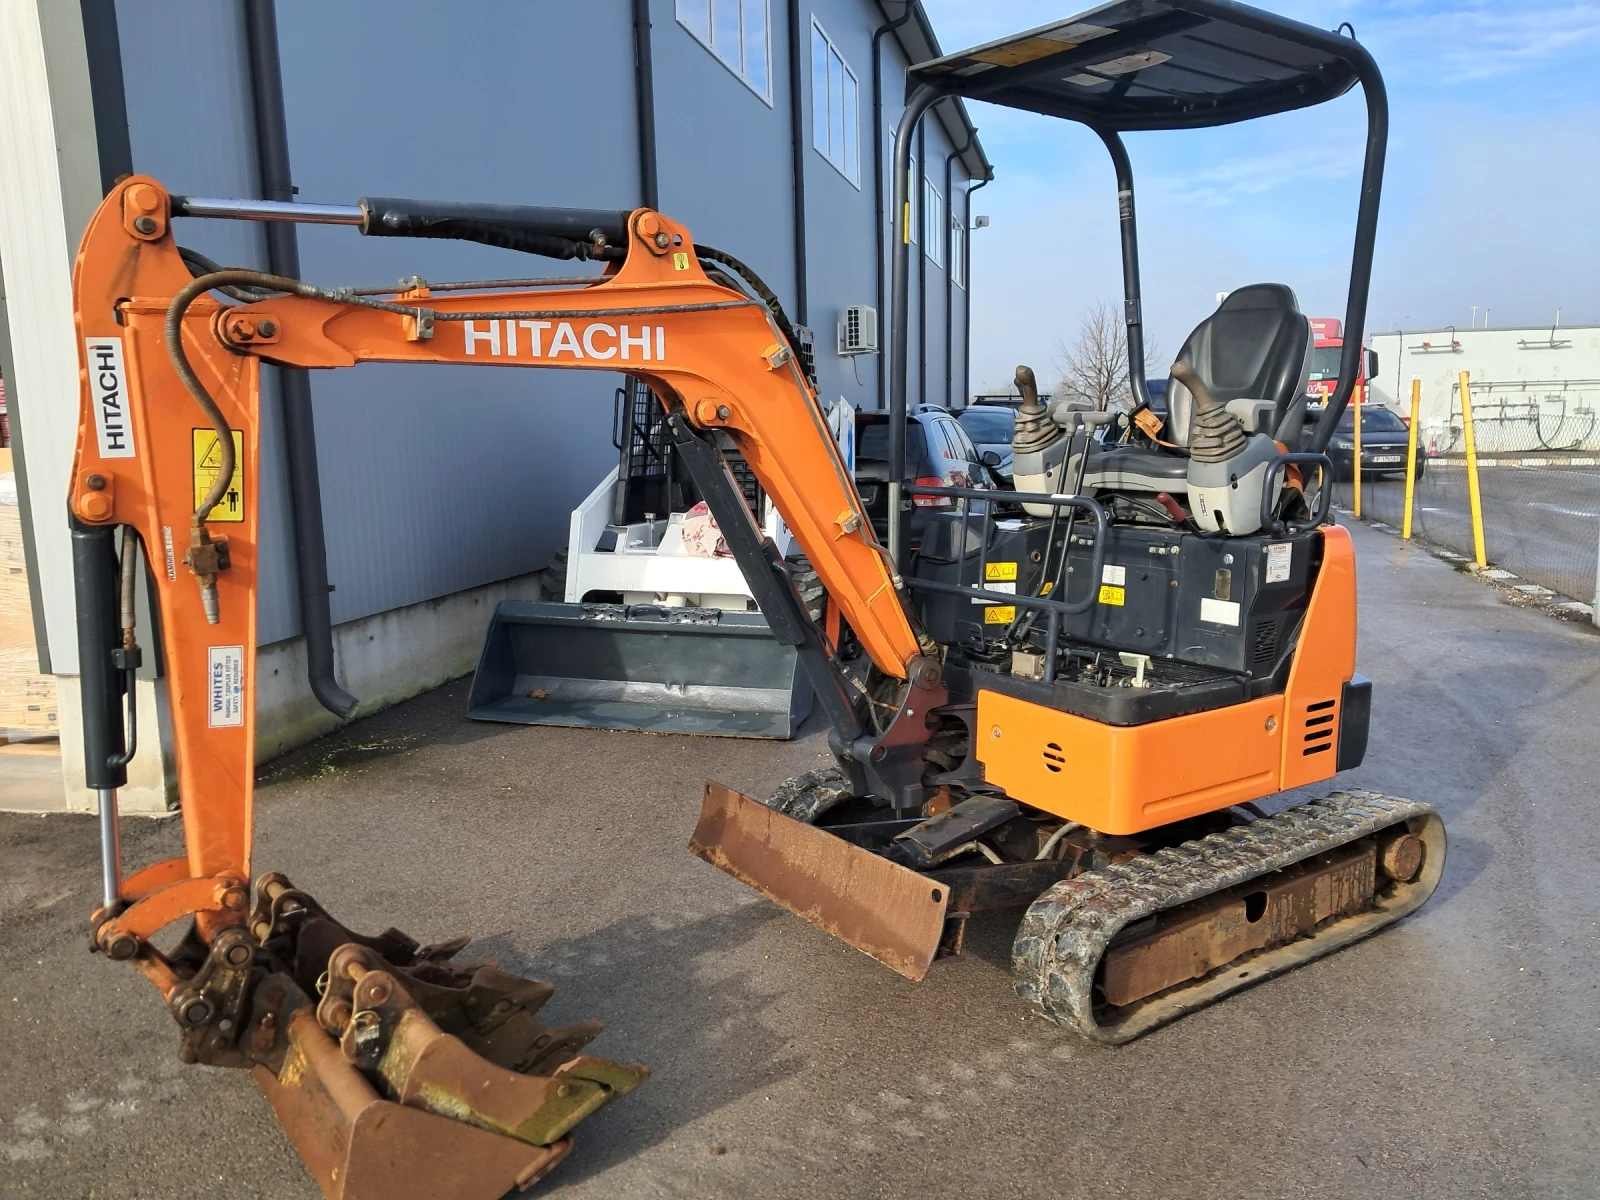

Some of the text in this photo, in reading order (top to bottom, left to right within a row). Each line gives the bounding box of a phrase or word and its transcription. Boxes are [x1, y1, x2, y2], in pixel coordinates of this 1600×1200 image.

[464, 320, 665, 360] HITACHI
[95, 345, 126, 450] HITACHI
[166, 548, 175, 581] HAMMER
[213, 663, 223, 712] WHITES
